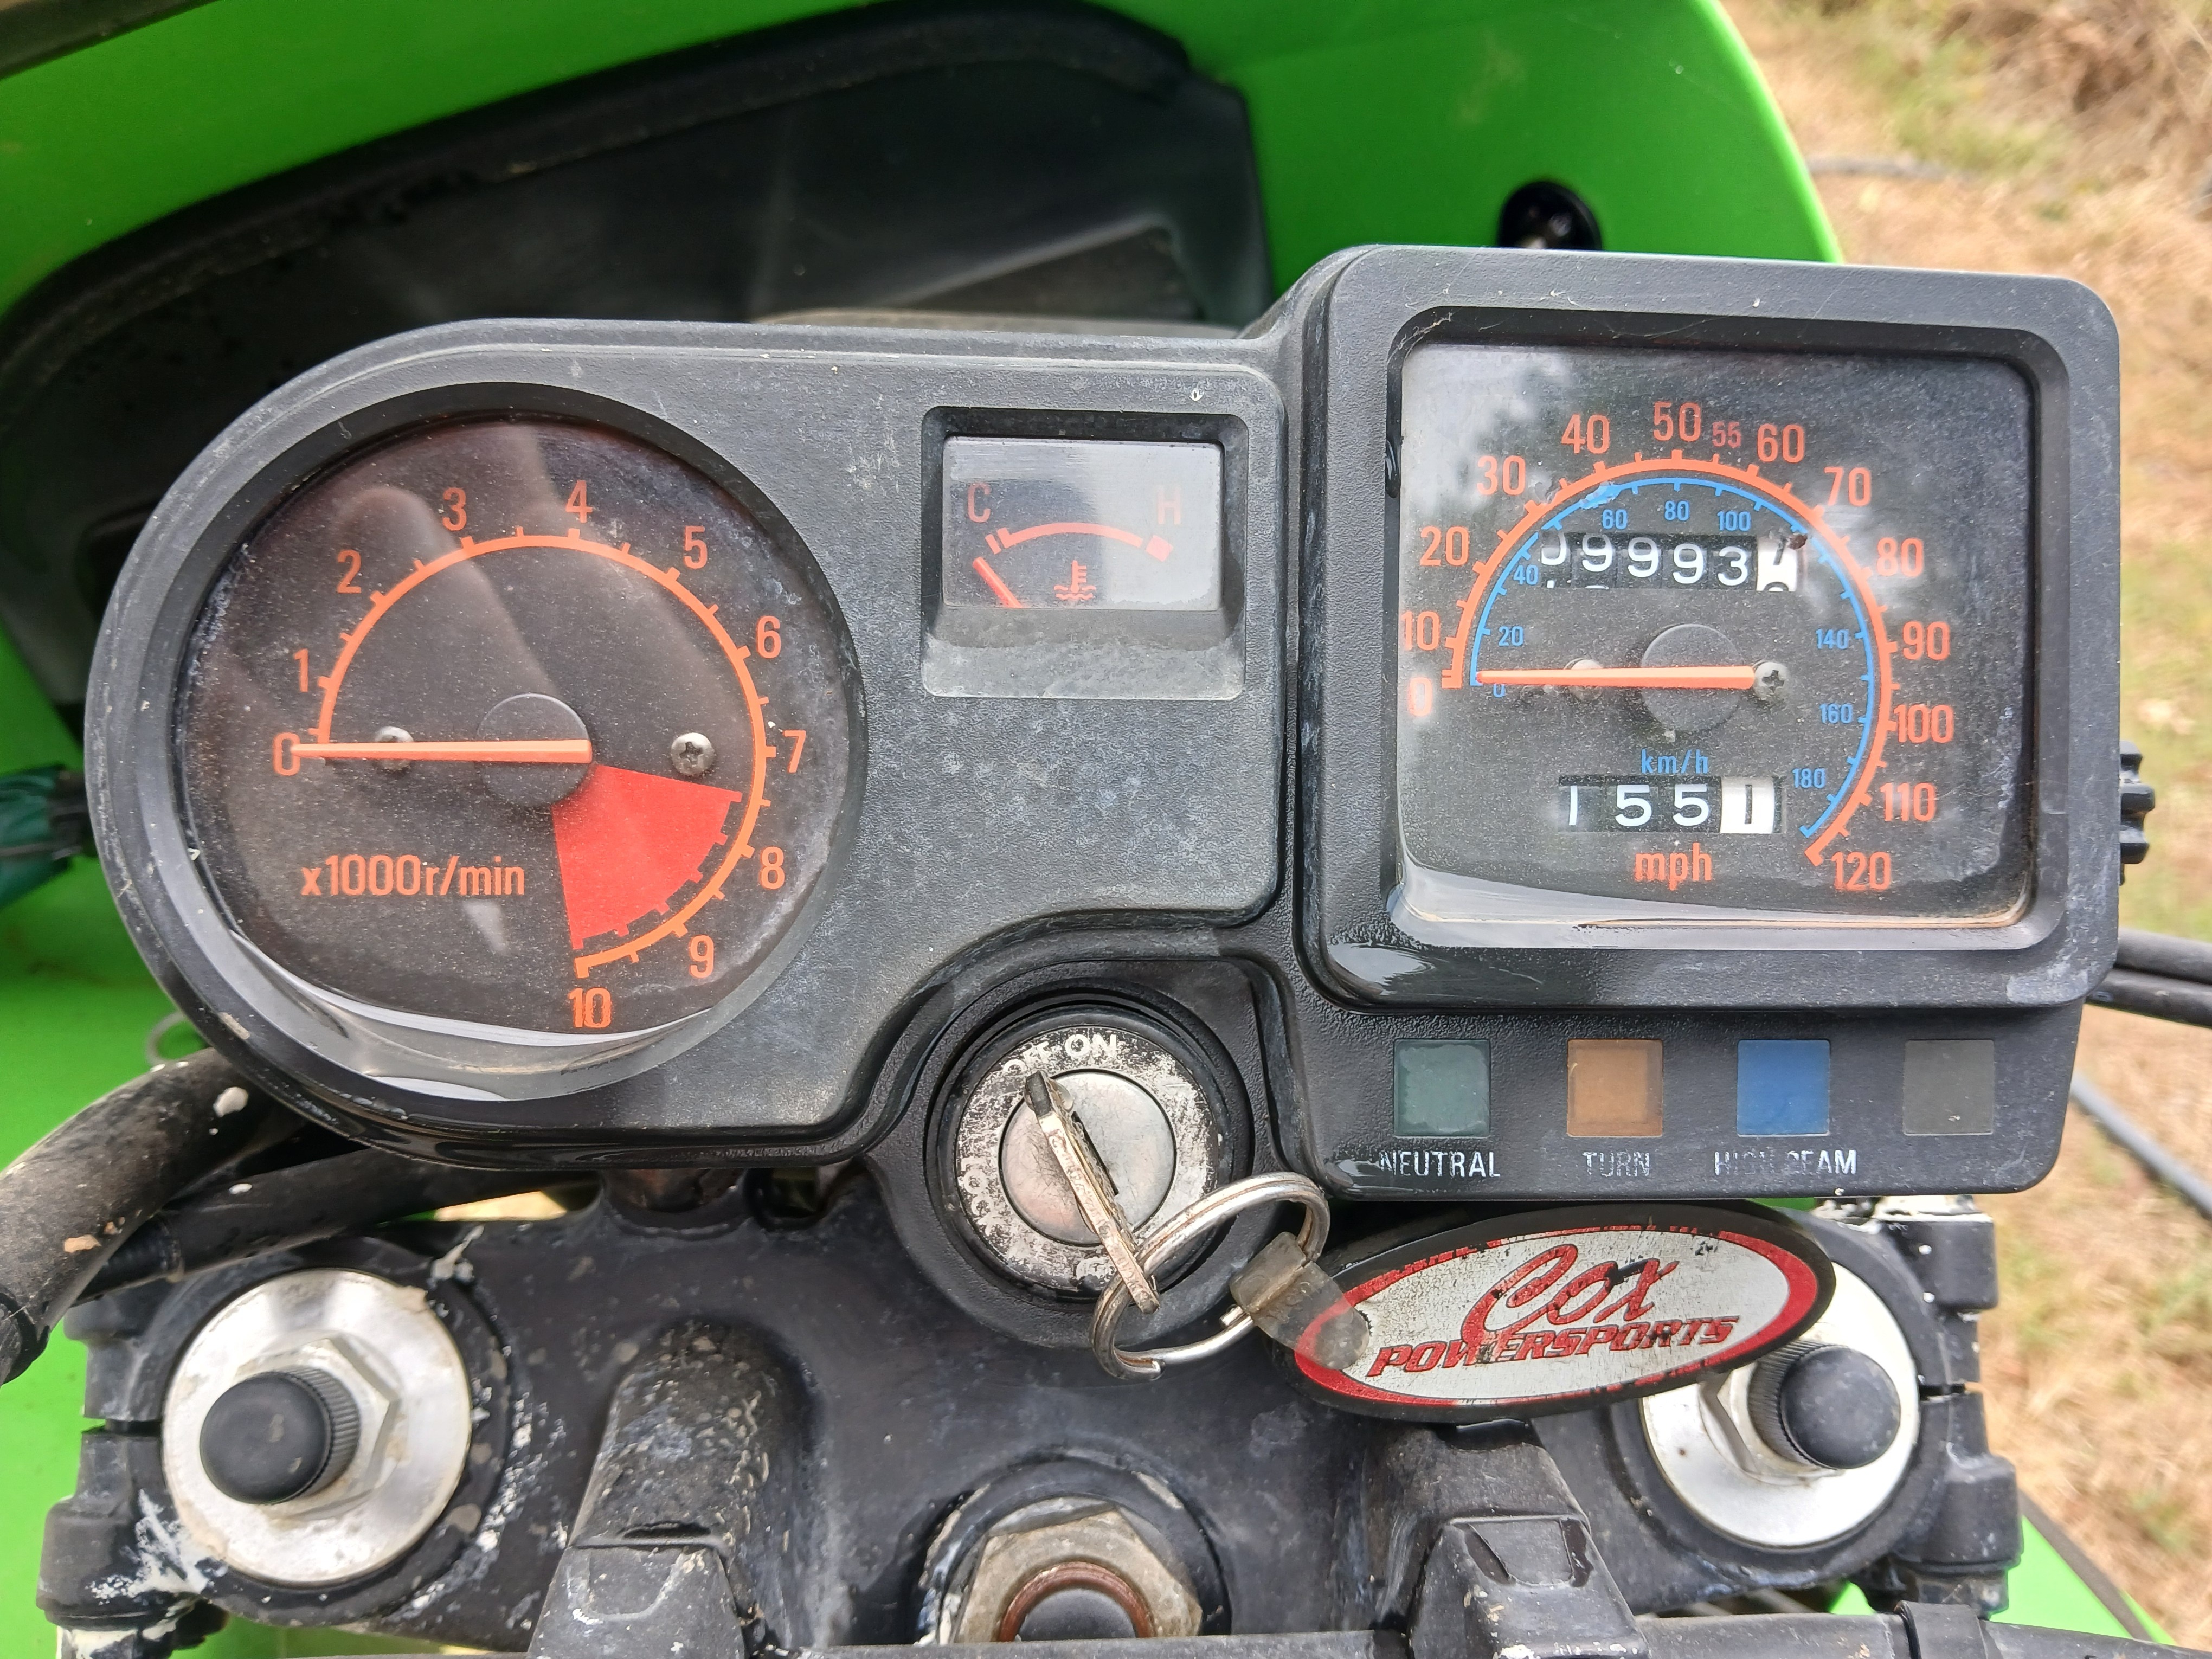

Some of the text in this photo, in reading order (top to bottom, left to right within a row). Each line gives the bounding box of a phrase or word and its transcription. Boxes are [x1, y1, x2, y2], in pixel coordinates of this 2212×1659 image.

[1561, 414, 1610, 454] 40
[1653, 402, 1701, 442] 50
[1712, 422, 1741, 448] 55
[1757, 424, 1804, 464] 60
[1478, 456, 1526, 496] 30
[1824, 467, 1870, 506] 70
[442, 488, 467, 531] 3
[564, 480, 593, 524] 4
[968, 484, 991, 523] C
[1156, 485, 1182, 525] H
[1602, 509, 1628, 530] 60
[1664, 500, 1689, 521] 80
[1718, 511, 1751, 531] 100
[683, 526, 708, 569] 5
[1420, 526, 1469, 567] 20
[1877, 538, 1923, 576] 80
[337, 550, 361, 594] 2
[1513, 564, 1539, 586] 40
[756, 616, 781, 659] 6
[1401, 610, 1441, 651] 10
[1499, 626, 1523, 646] 20
[1816, 629, 1849, 649] 140
[1902, 621, 1950, 660] 90
[294, 648, 308, 692] 1
[1407, 676, 1433, 716] 0
[1819, 703, 1853, 724] 160
[1896, 704, 1953, 743] 100
[273, 732, 301, 776] 0
[782, 729, 806, 773] 7
[1641, 749, 1708, 774] km/h
[1792, 768, 1826, 788] 180
[1880, 782, 1936, 822] 110
[758, 846, 785, 890] 8
[1634, 842, 1712, 891] mph
[1831, 852, 1891, 891] 120
[688, 934, 714, 978] 9
[568, 987, 612, 1028] 10
[1064, 1033, 1117, 1058] ON
[1379, 1150, 1500, 1178] NEUTRAL
[1581, 1152, 1650, 1178] TURN
[1461, 1243, 1680, 1345] Cox
[1366, 1315, 1740, 1377] POWERSPORTS
